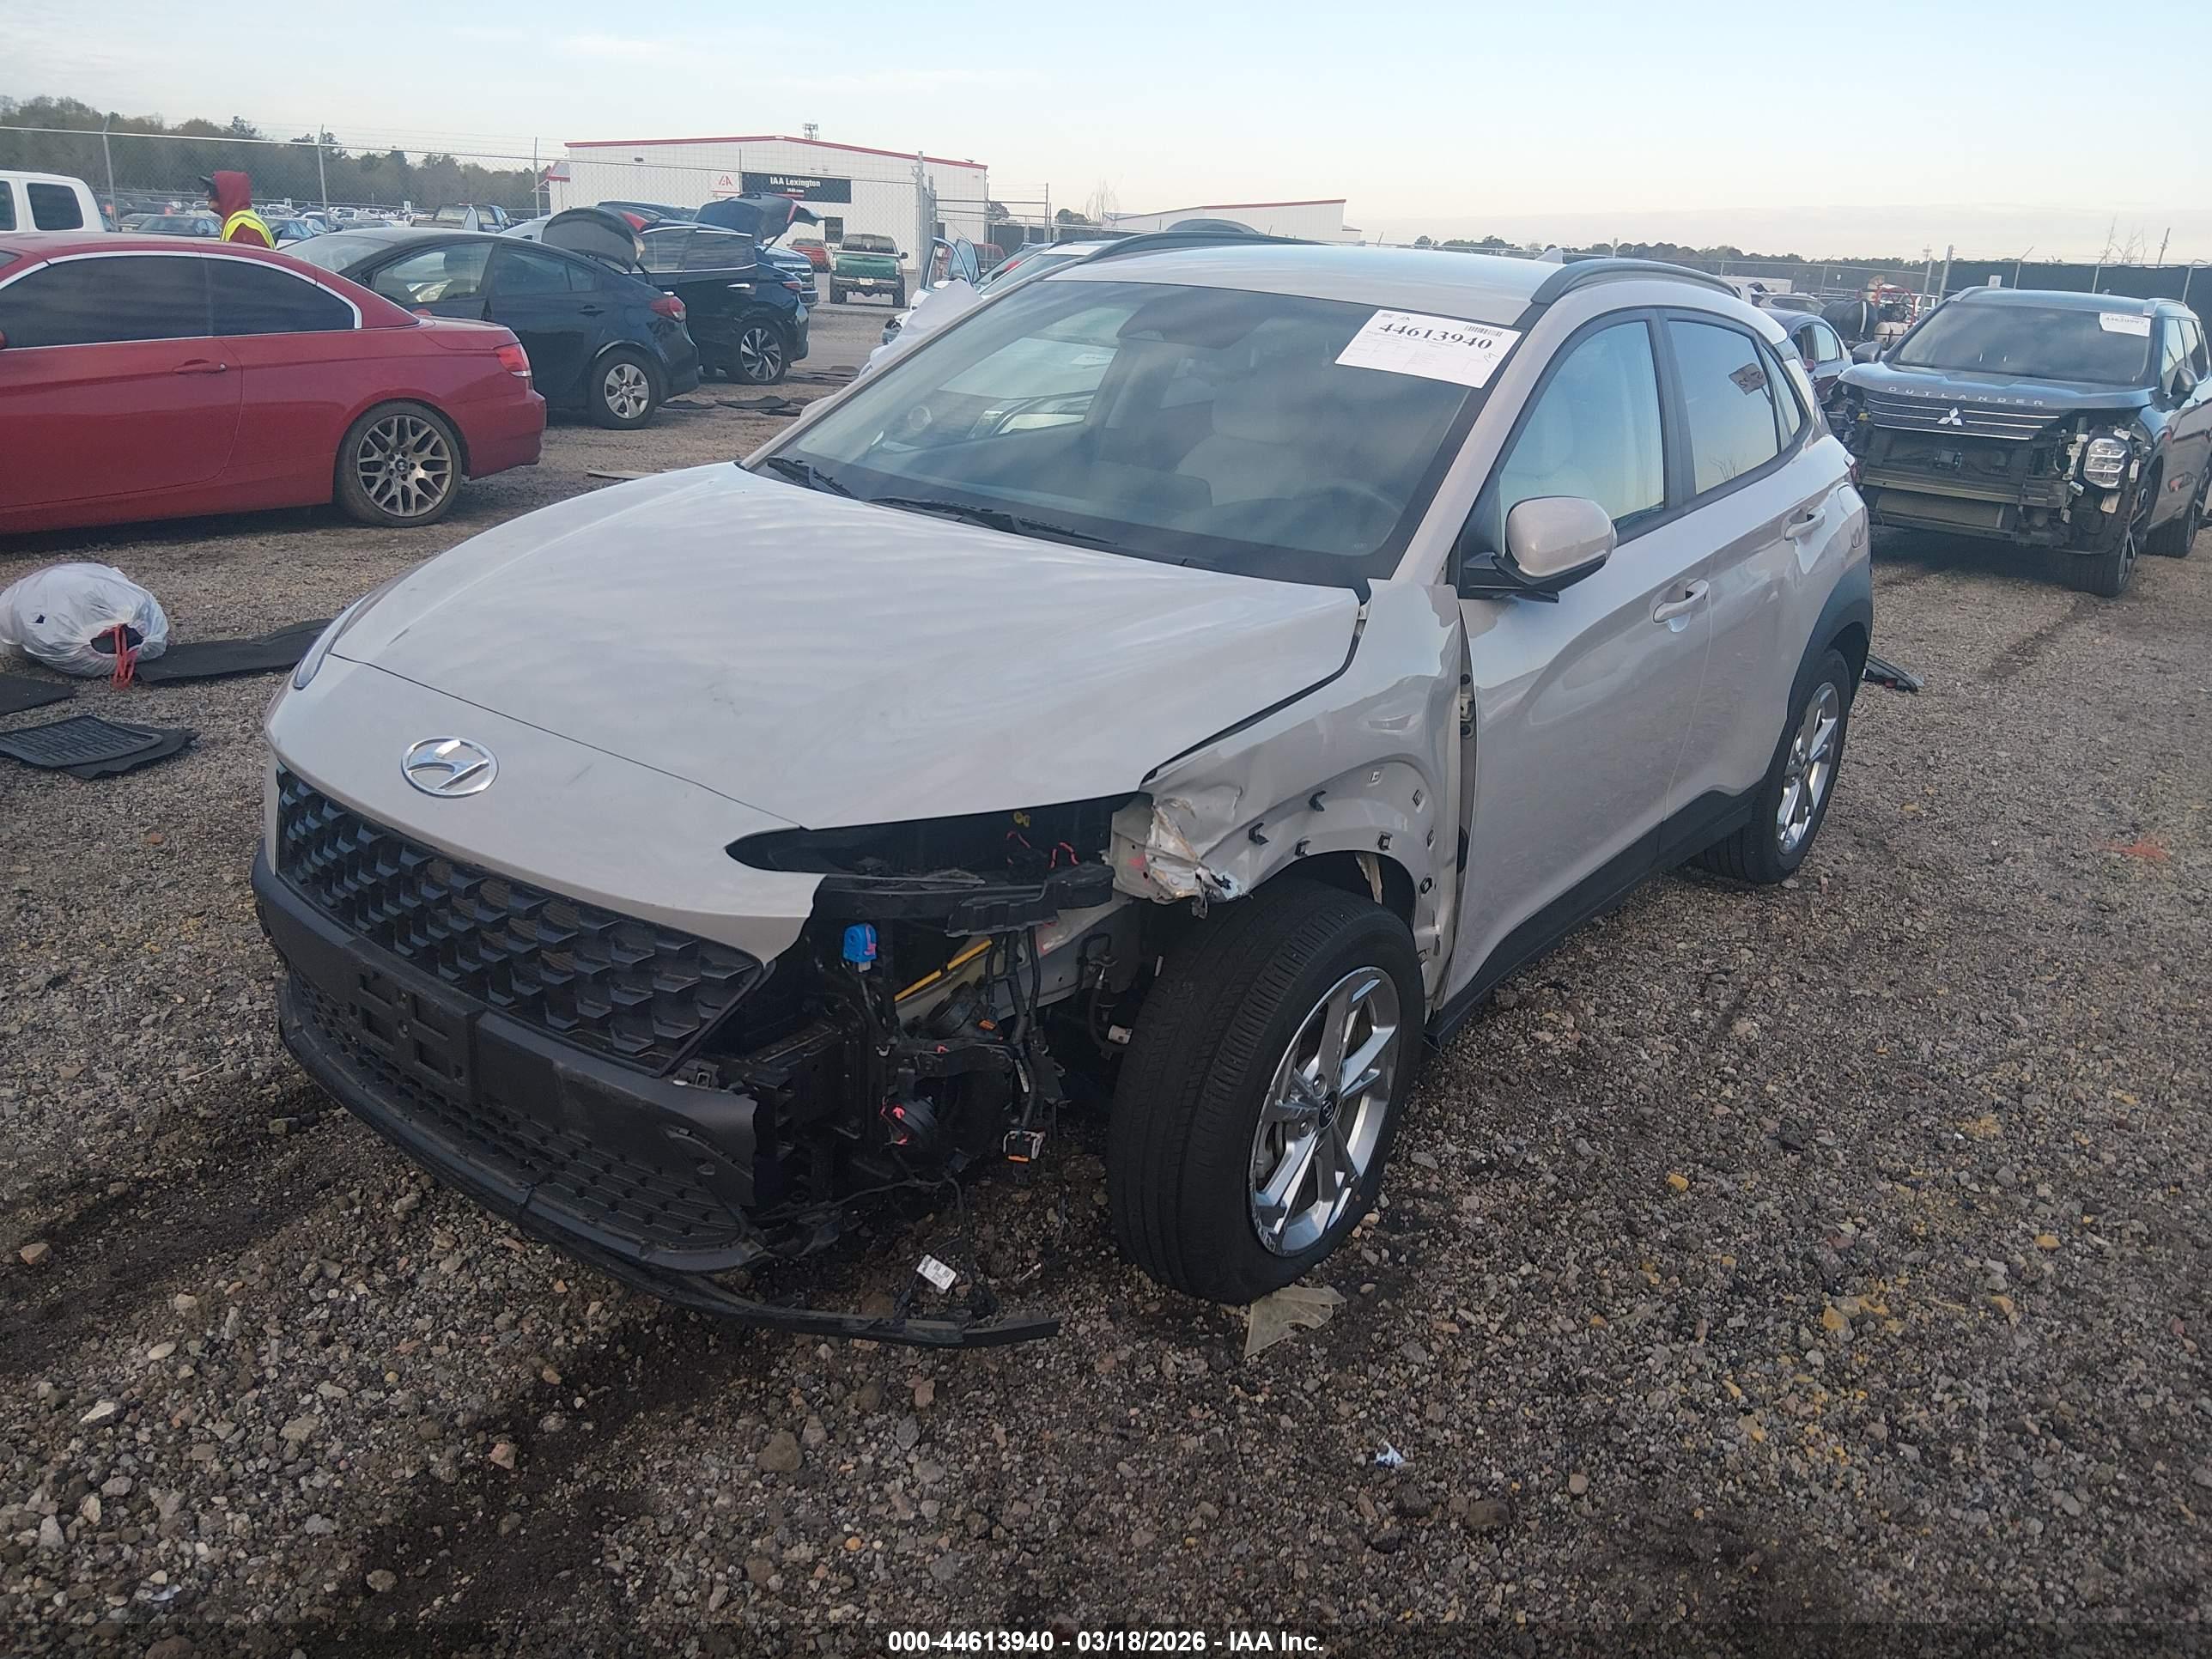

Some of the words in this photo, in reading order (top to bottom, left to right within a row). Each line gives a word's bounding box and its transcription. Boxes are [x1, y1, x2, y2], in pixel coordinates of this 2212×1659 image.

[769, 176, 784, 185] IAA
[1379, 323, 1492, 349] 44613940
[1888, 386, 2045, 406] OUTLANDER
